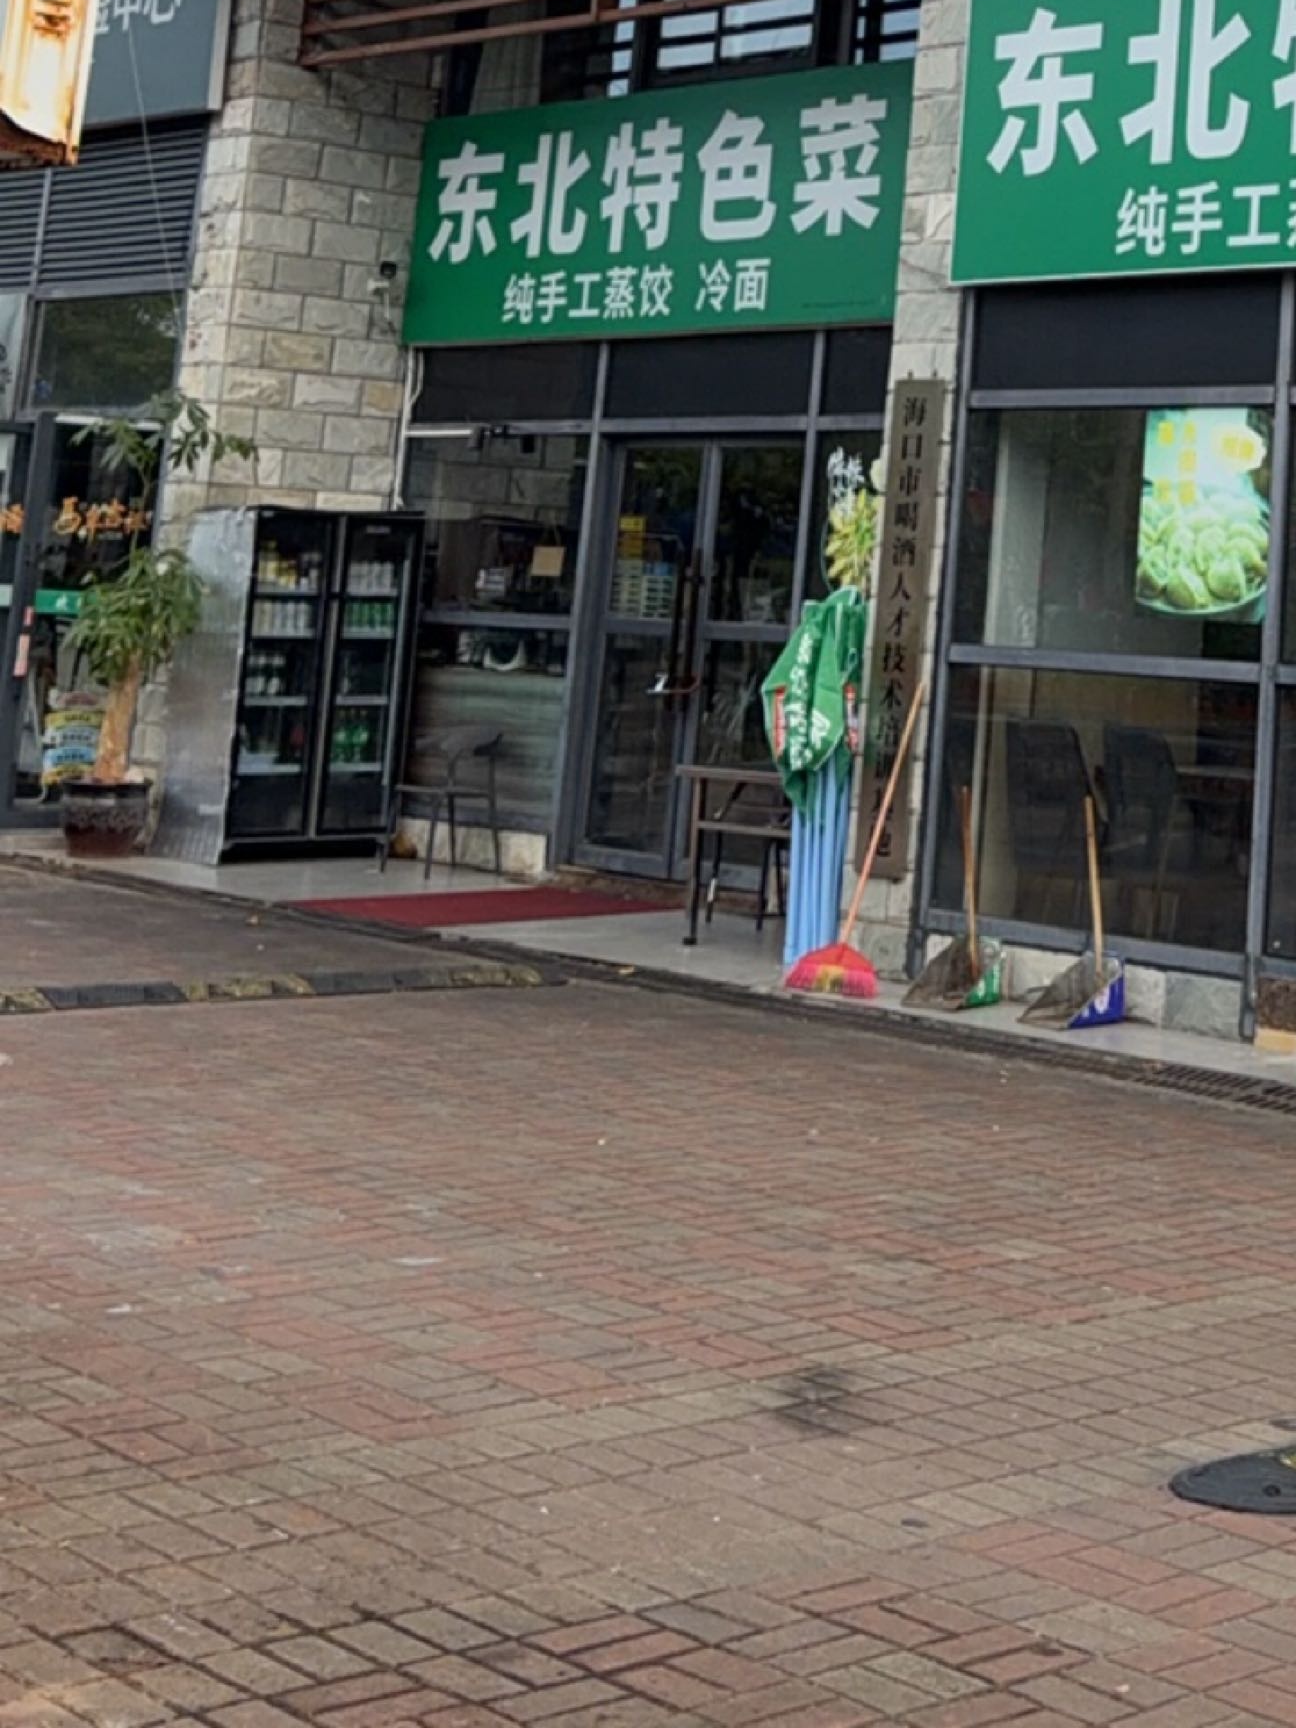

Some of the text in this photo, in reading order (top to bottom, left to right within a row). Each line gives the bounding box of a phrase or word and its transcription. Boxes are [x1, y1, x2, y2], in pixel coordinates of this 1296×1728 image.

[427, 93, 888, 265] 东北特色菜
[501, 257, 772, 325] 纯手工蒸饺 冷面
